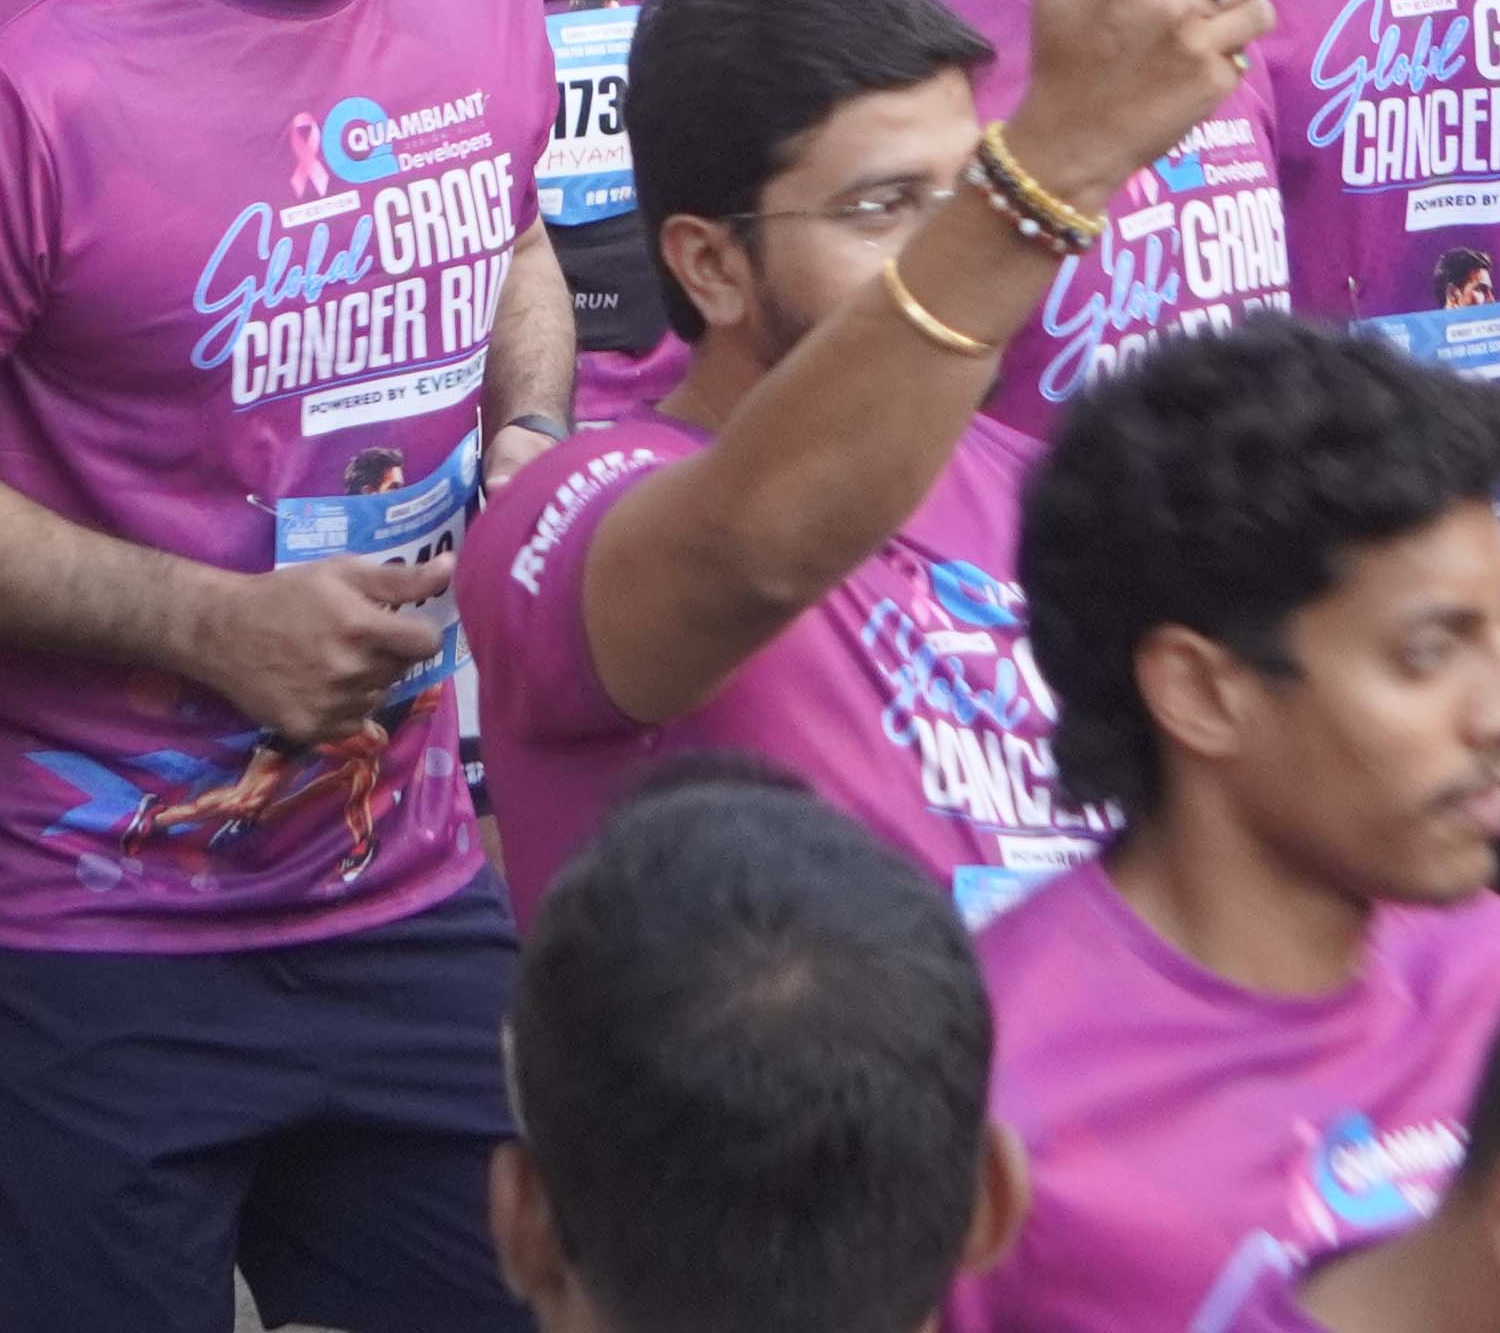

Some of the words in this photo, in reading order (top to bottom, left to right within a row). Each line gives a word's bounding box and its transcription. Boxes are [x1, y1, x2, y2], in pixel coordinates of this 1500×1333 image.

[347, 90, 487, 153] QUAMBIANT
[398, 130, 494, 174] Developers
[1482, 193, 1499, 207] BY
[190, 199, 376, 370] Global
[373, 151, 516, 273] GRACE
[574, 292, 619, 310] RUN
[230, 278, 430, 408] CANCER
[307, 390, 386, 419] POWERED
[387, 384, 407, 402] BY
